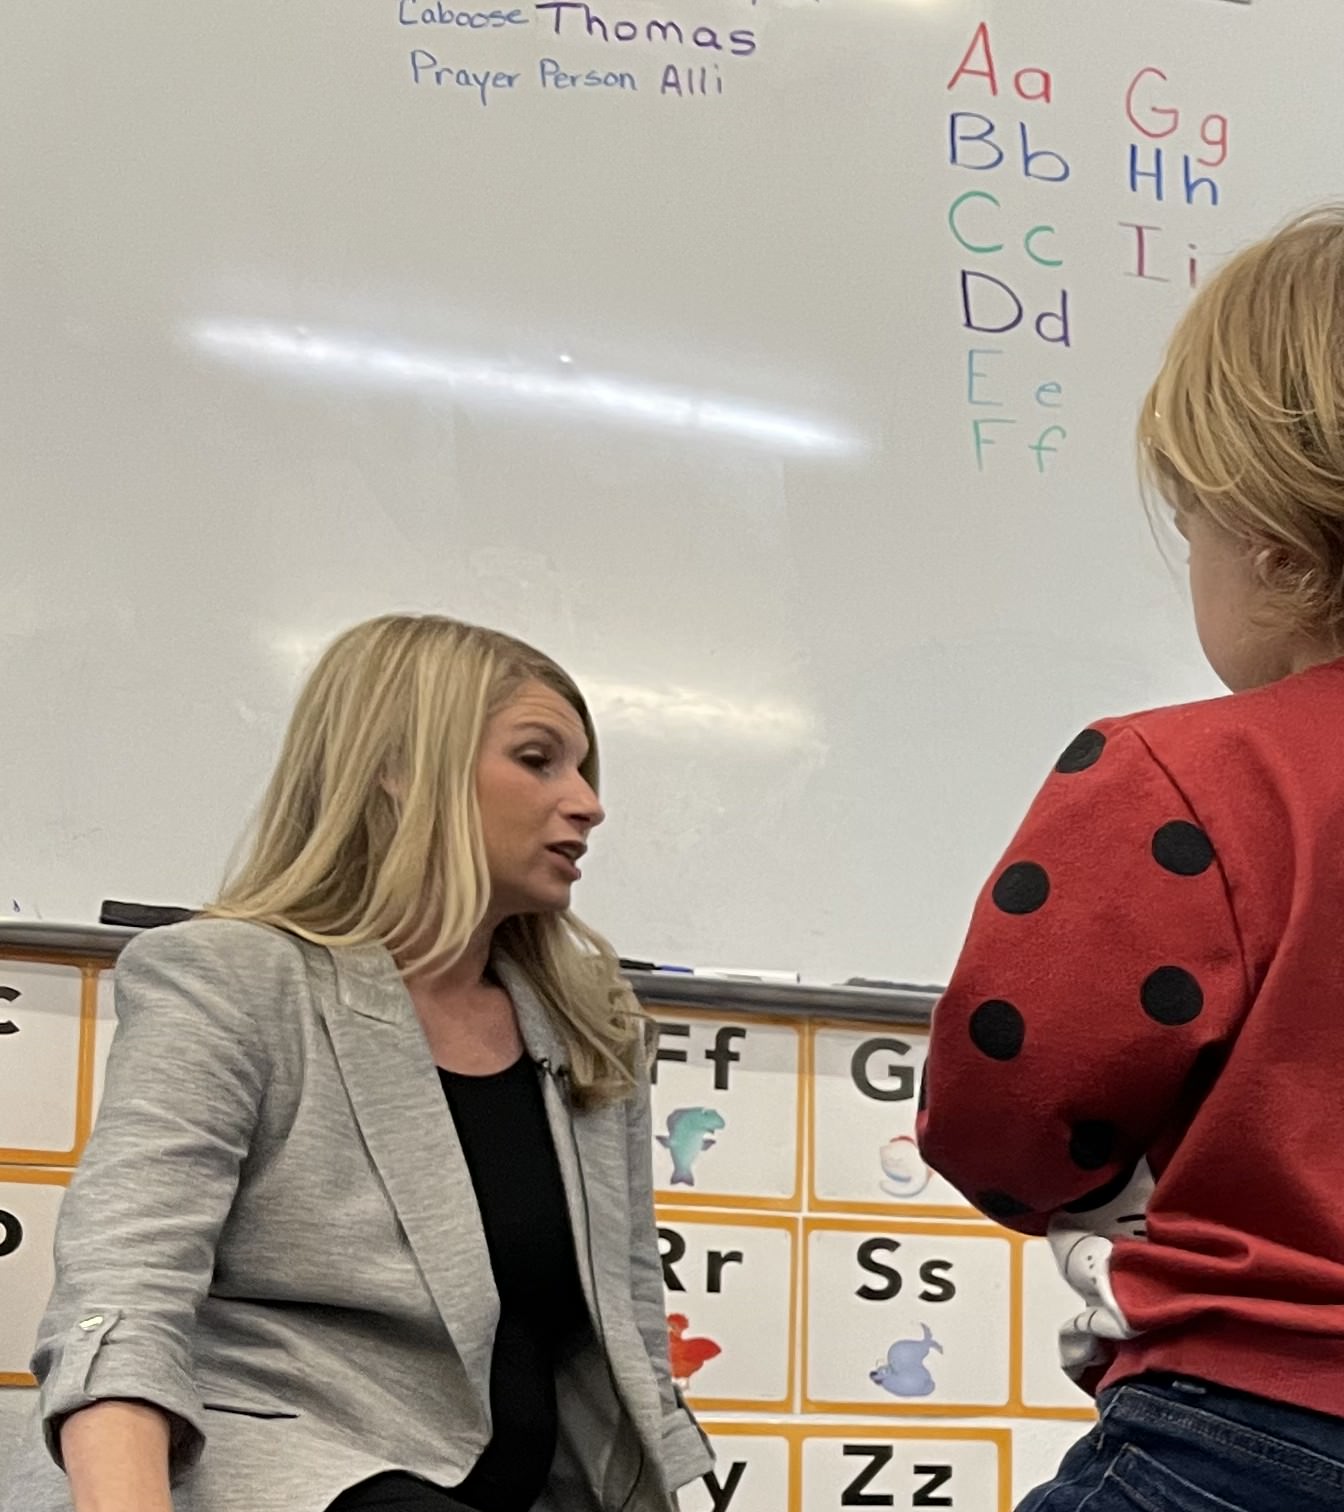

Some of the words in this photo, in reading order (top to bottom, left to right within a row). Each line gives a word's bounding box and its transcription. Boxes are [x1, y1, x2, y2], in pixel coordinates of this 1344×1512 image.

[535, 2, 757, 56] Thomas
[410, 49, 521, 106] Prayer
[539, 57, 638, 92] Person
[660, 63, 724, 97] Alli
[645, 1023, 747, 1090] Ff
[851, 1037, 915, 1102] G
[854, 1237, 957, 1302] Ss
[841, 1445, 954, 1507] Zz
